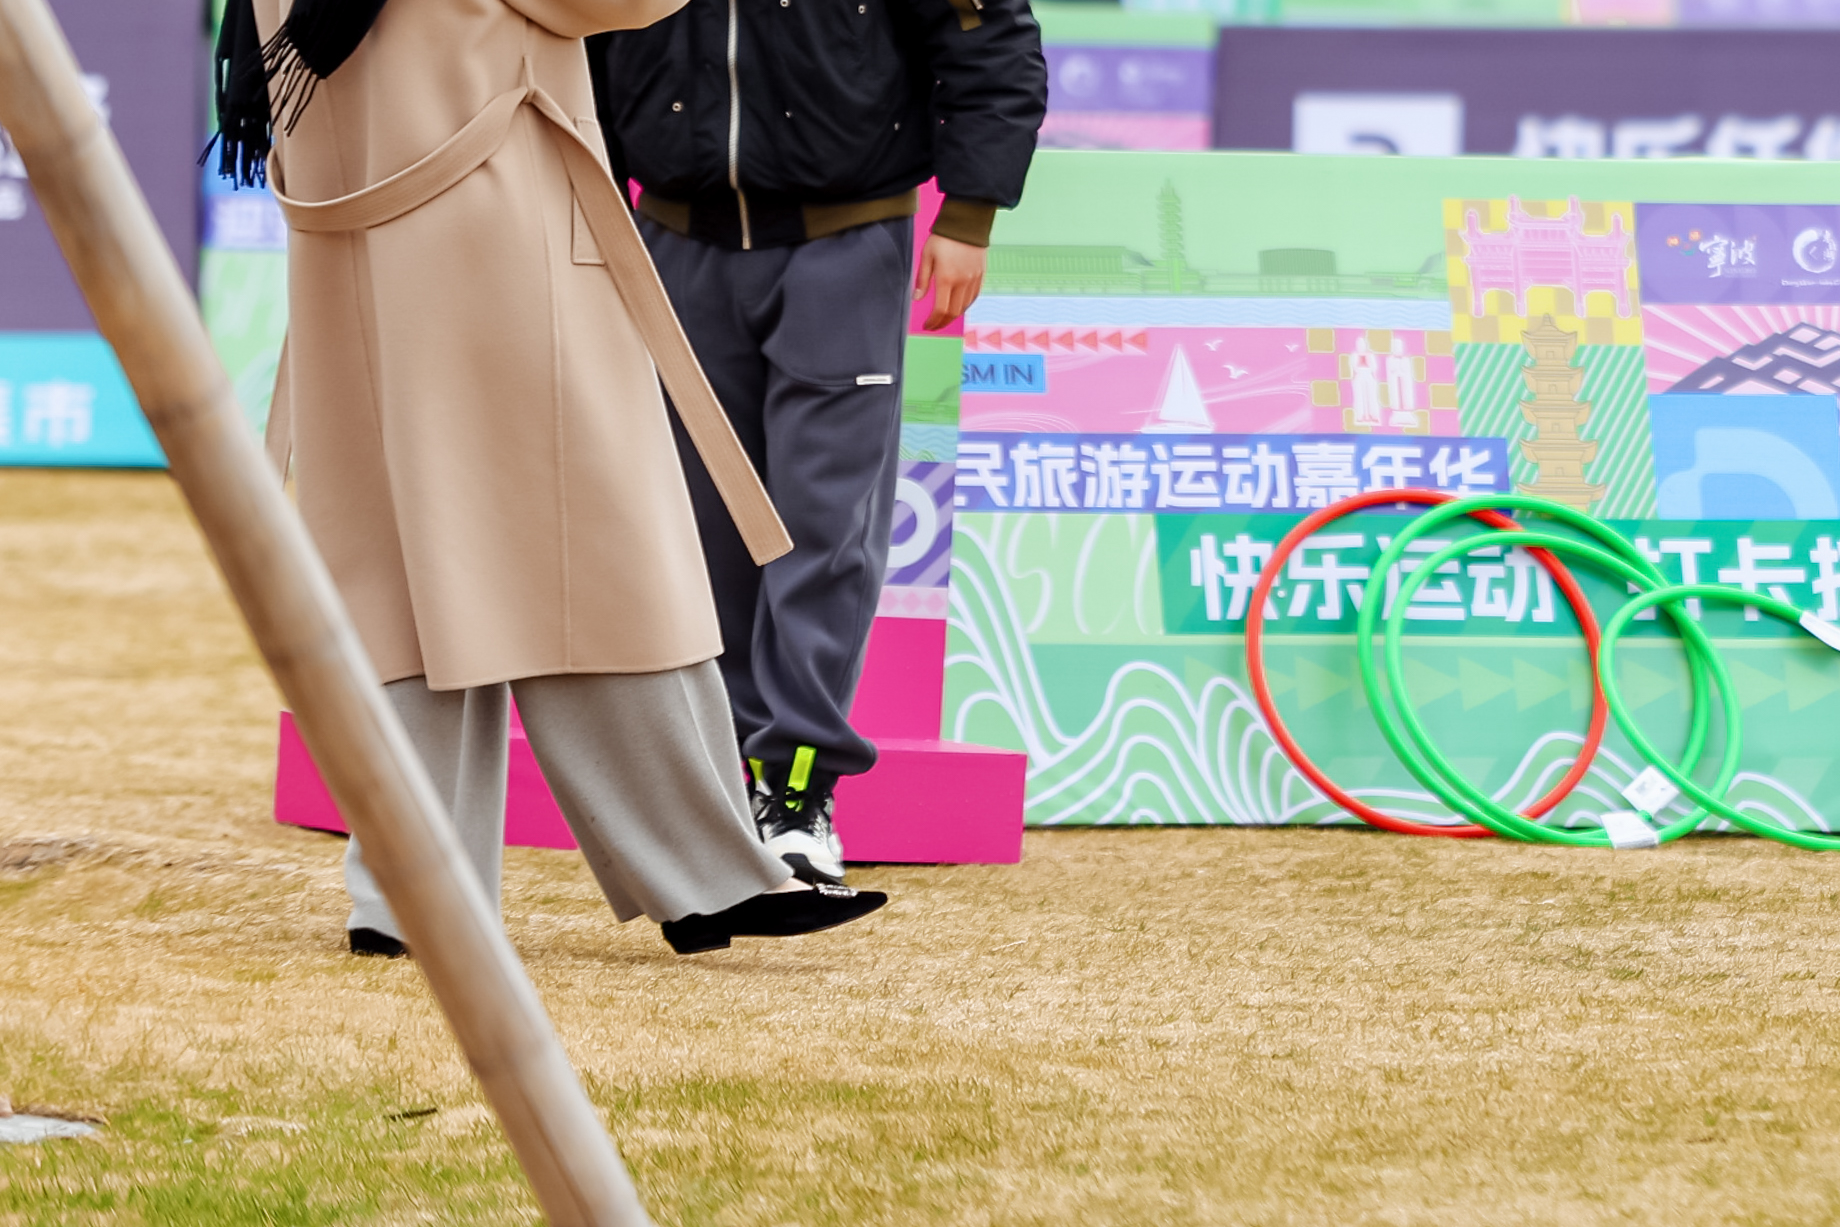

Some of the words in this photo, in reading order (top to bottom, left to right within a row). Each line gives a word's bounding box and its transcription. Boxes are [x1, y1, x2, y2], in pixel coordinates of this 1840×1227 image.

[1003, 364, 1033, 385] IN
[954, 440, 1496, 511] 民旅游运动嘉年华
